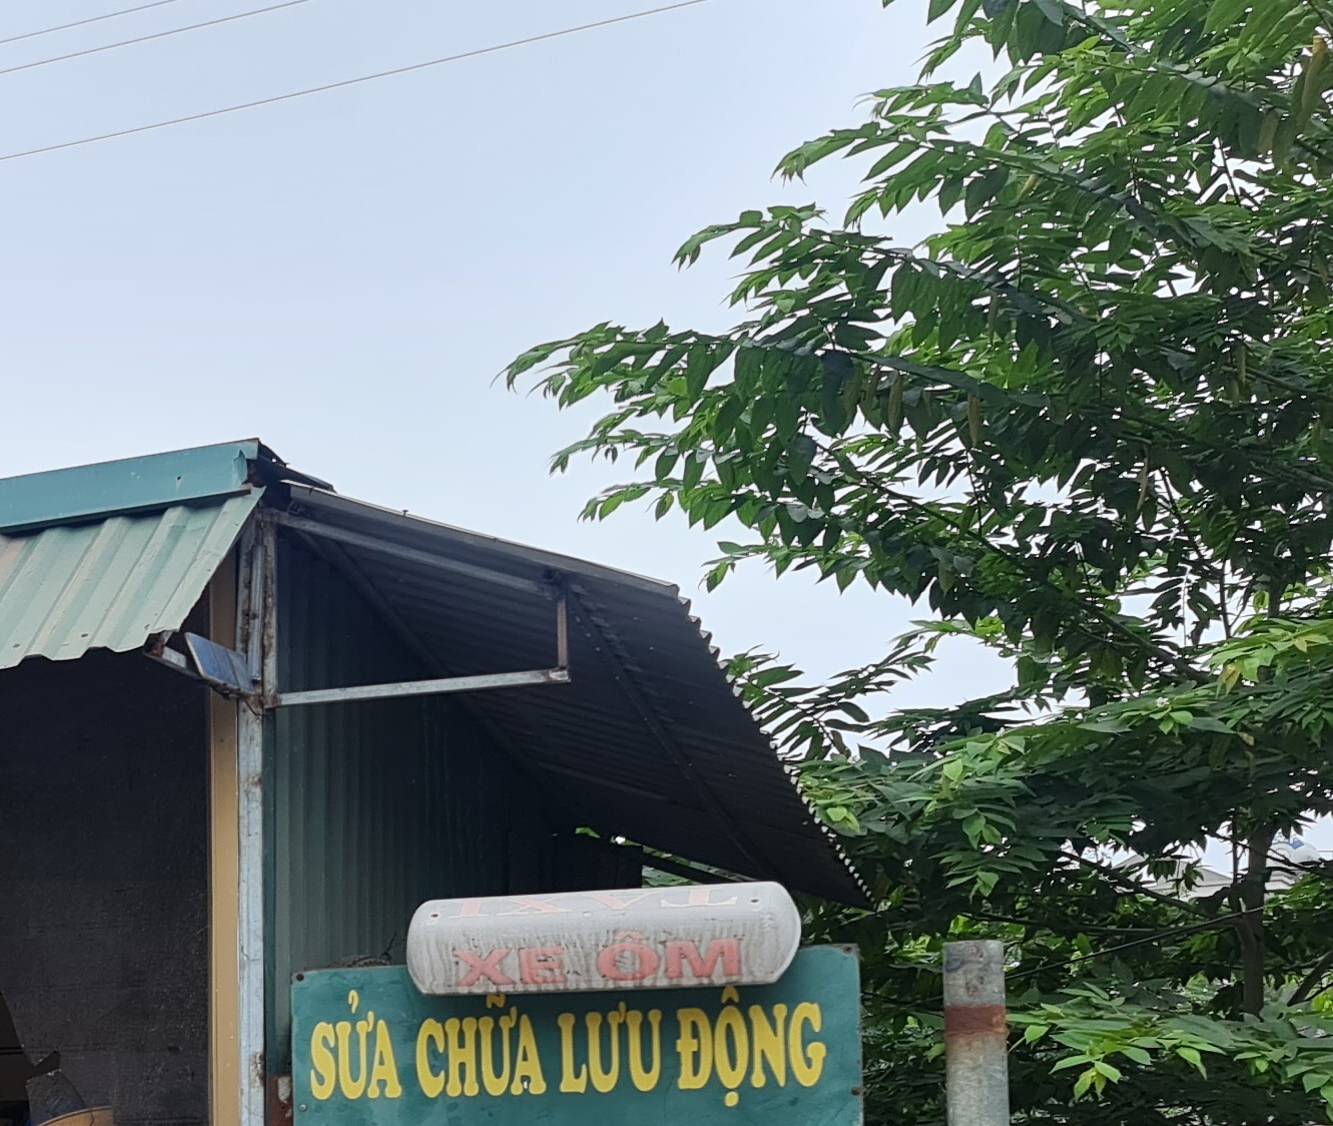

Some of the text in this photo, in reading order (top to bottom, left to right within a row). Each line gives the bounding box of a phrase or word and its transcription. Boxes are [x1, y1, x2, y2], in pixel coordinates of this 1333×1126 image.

[453, 931, 742, 987] XE ÔM
[309, 985, 826, 1107] SỬA CHỮA LƯU ĐỘNG
